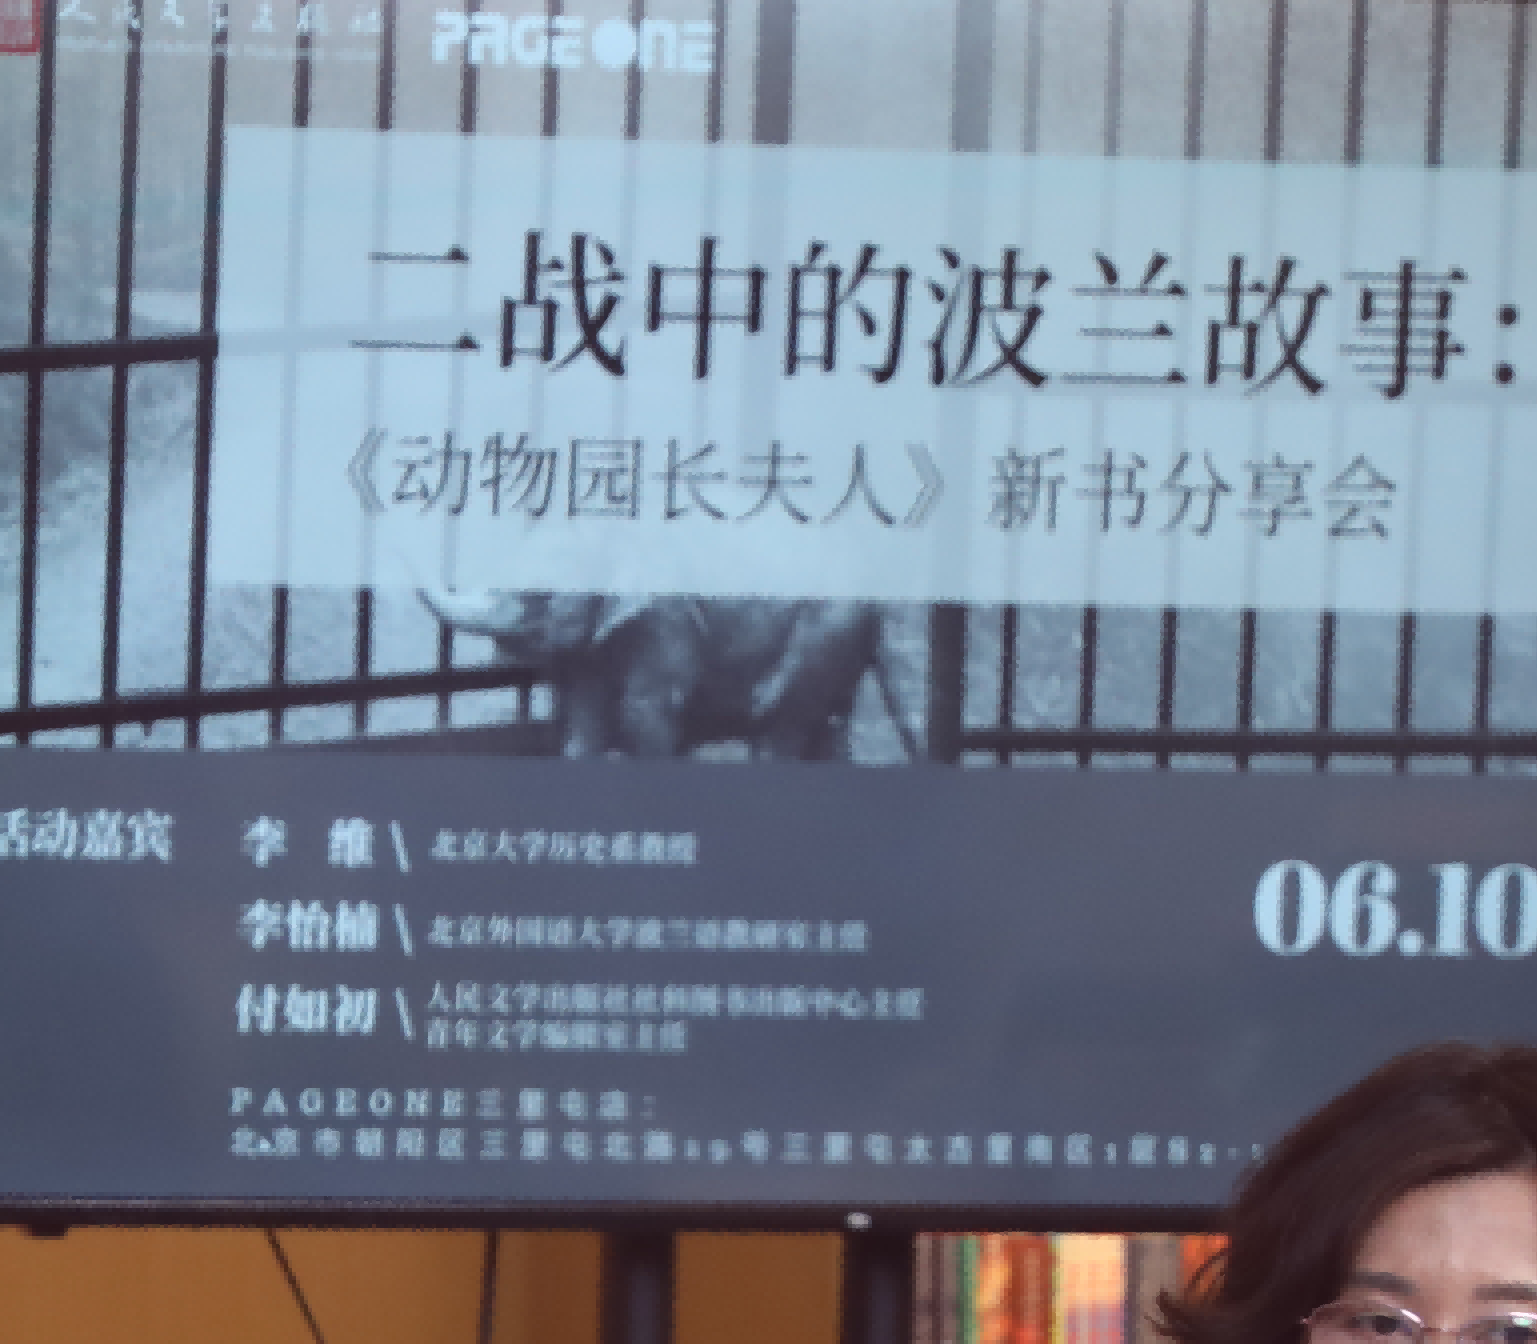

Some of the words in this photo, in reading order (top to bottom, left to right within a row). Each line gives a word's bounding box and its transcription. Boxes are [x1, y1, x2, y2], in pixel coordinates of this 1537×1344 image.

[431, 11, 586, 69] PAGE
[235, 983, 380, 1036] 付如初
